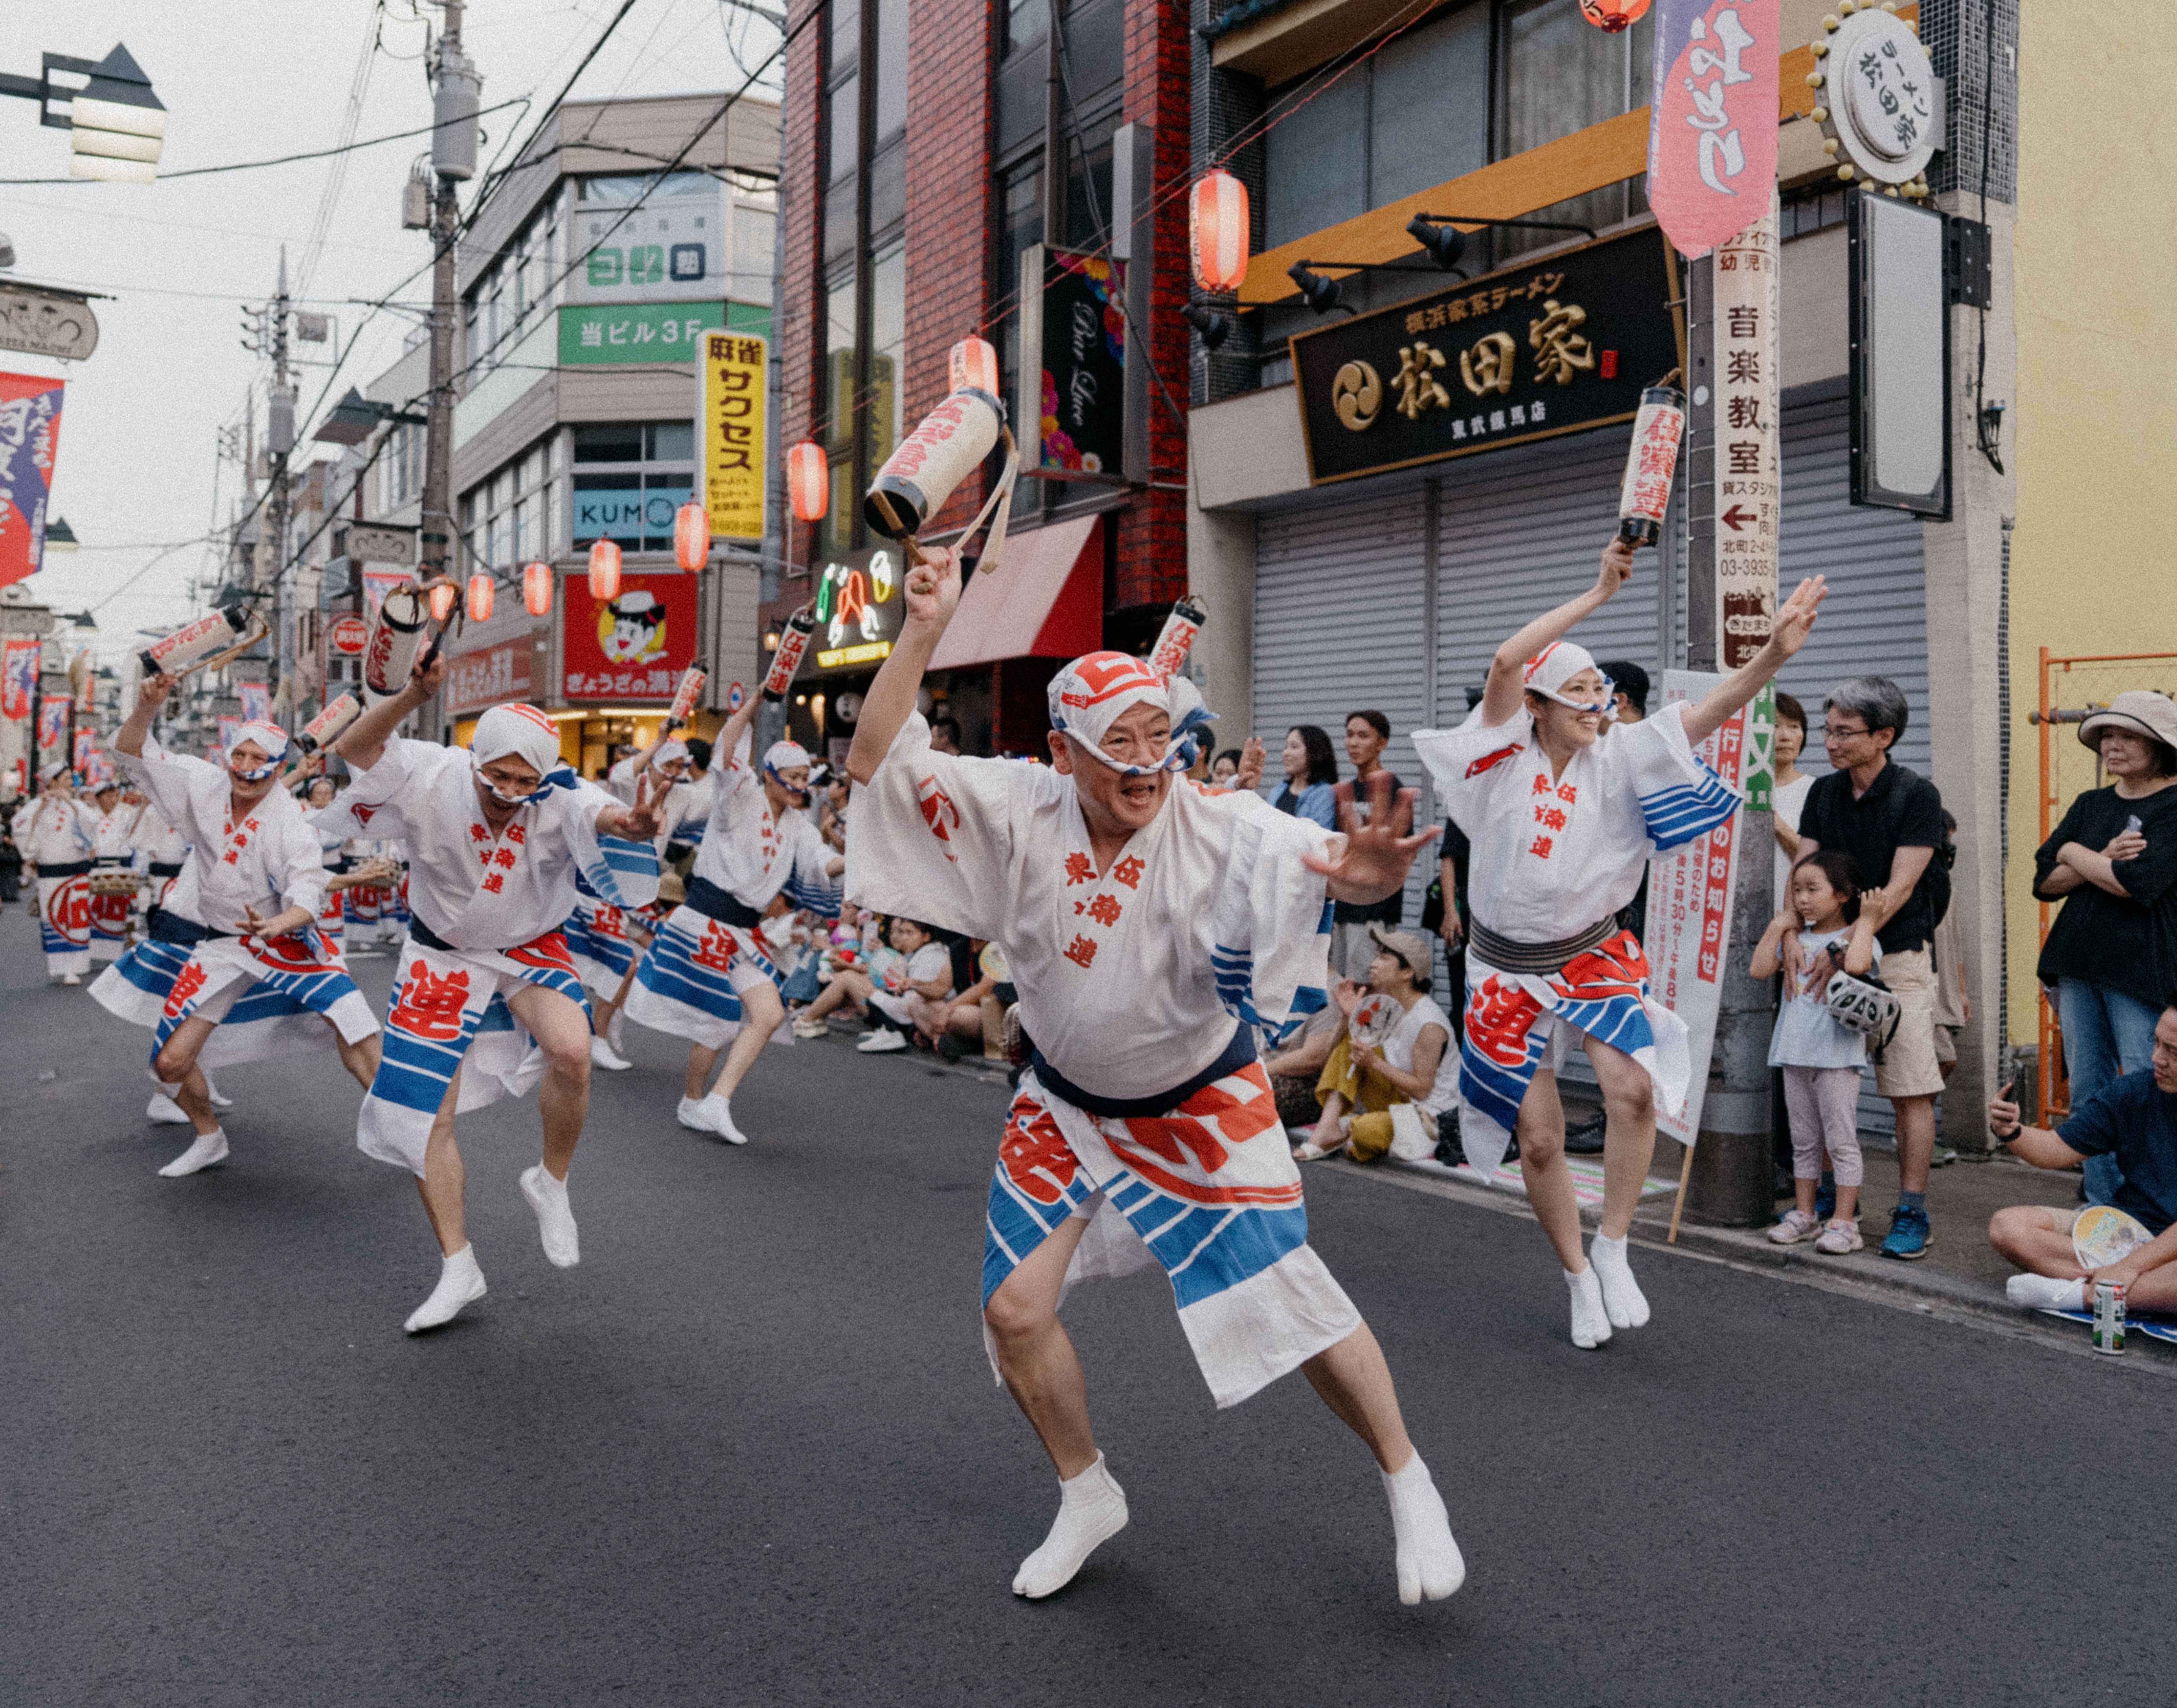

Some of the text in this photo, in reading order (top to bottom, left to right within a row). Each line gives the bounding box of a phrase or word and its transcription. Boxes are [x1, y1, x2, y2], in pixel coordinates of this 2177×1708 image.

[1859, 51, 1916, 150] 松田家
[1880, 40, 1929, 117] ラーメン
[581, 320, 702, 347] 当ビル3F
[1072, 301, 1098, 361] Bar
[1405, 272, 1565, 335] 横浜家系ラーメン
[710, 336, 762, 365] 麻雀
[1391, 299, 1596, 419] 松田家
[719, 368, 752, 471] サクセス
[1451, 400, 1546, 440] 東武練馬店
[1728, 304, 1760, 474] 音楽教室
